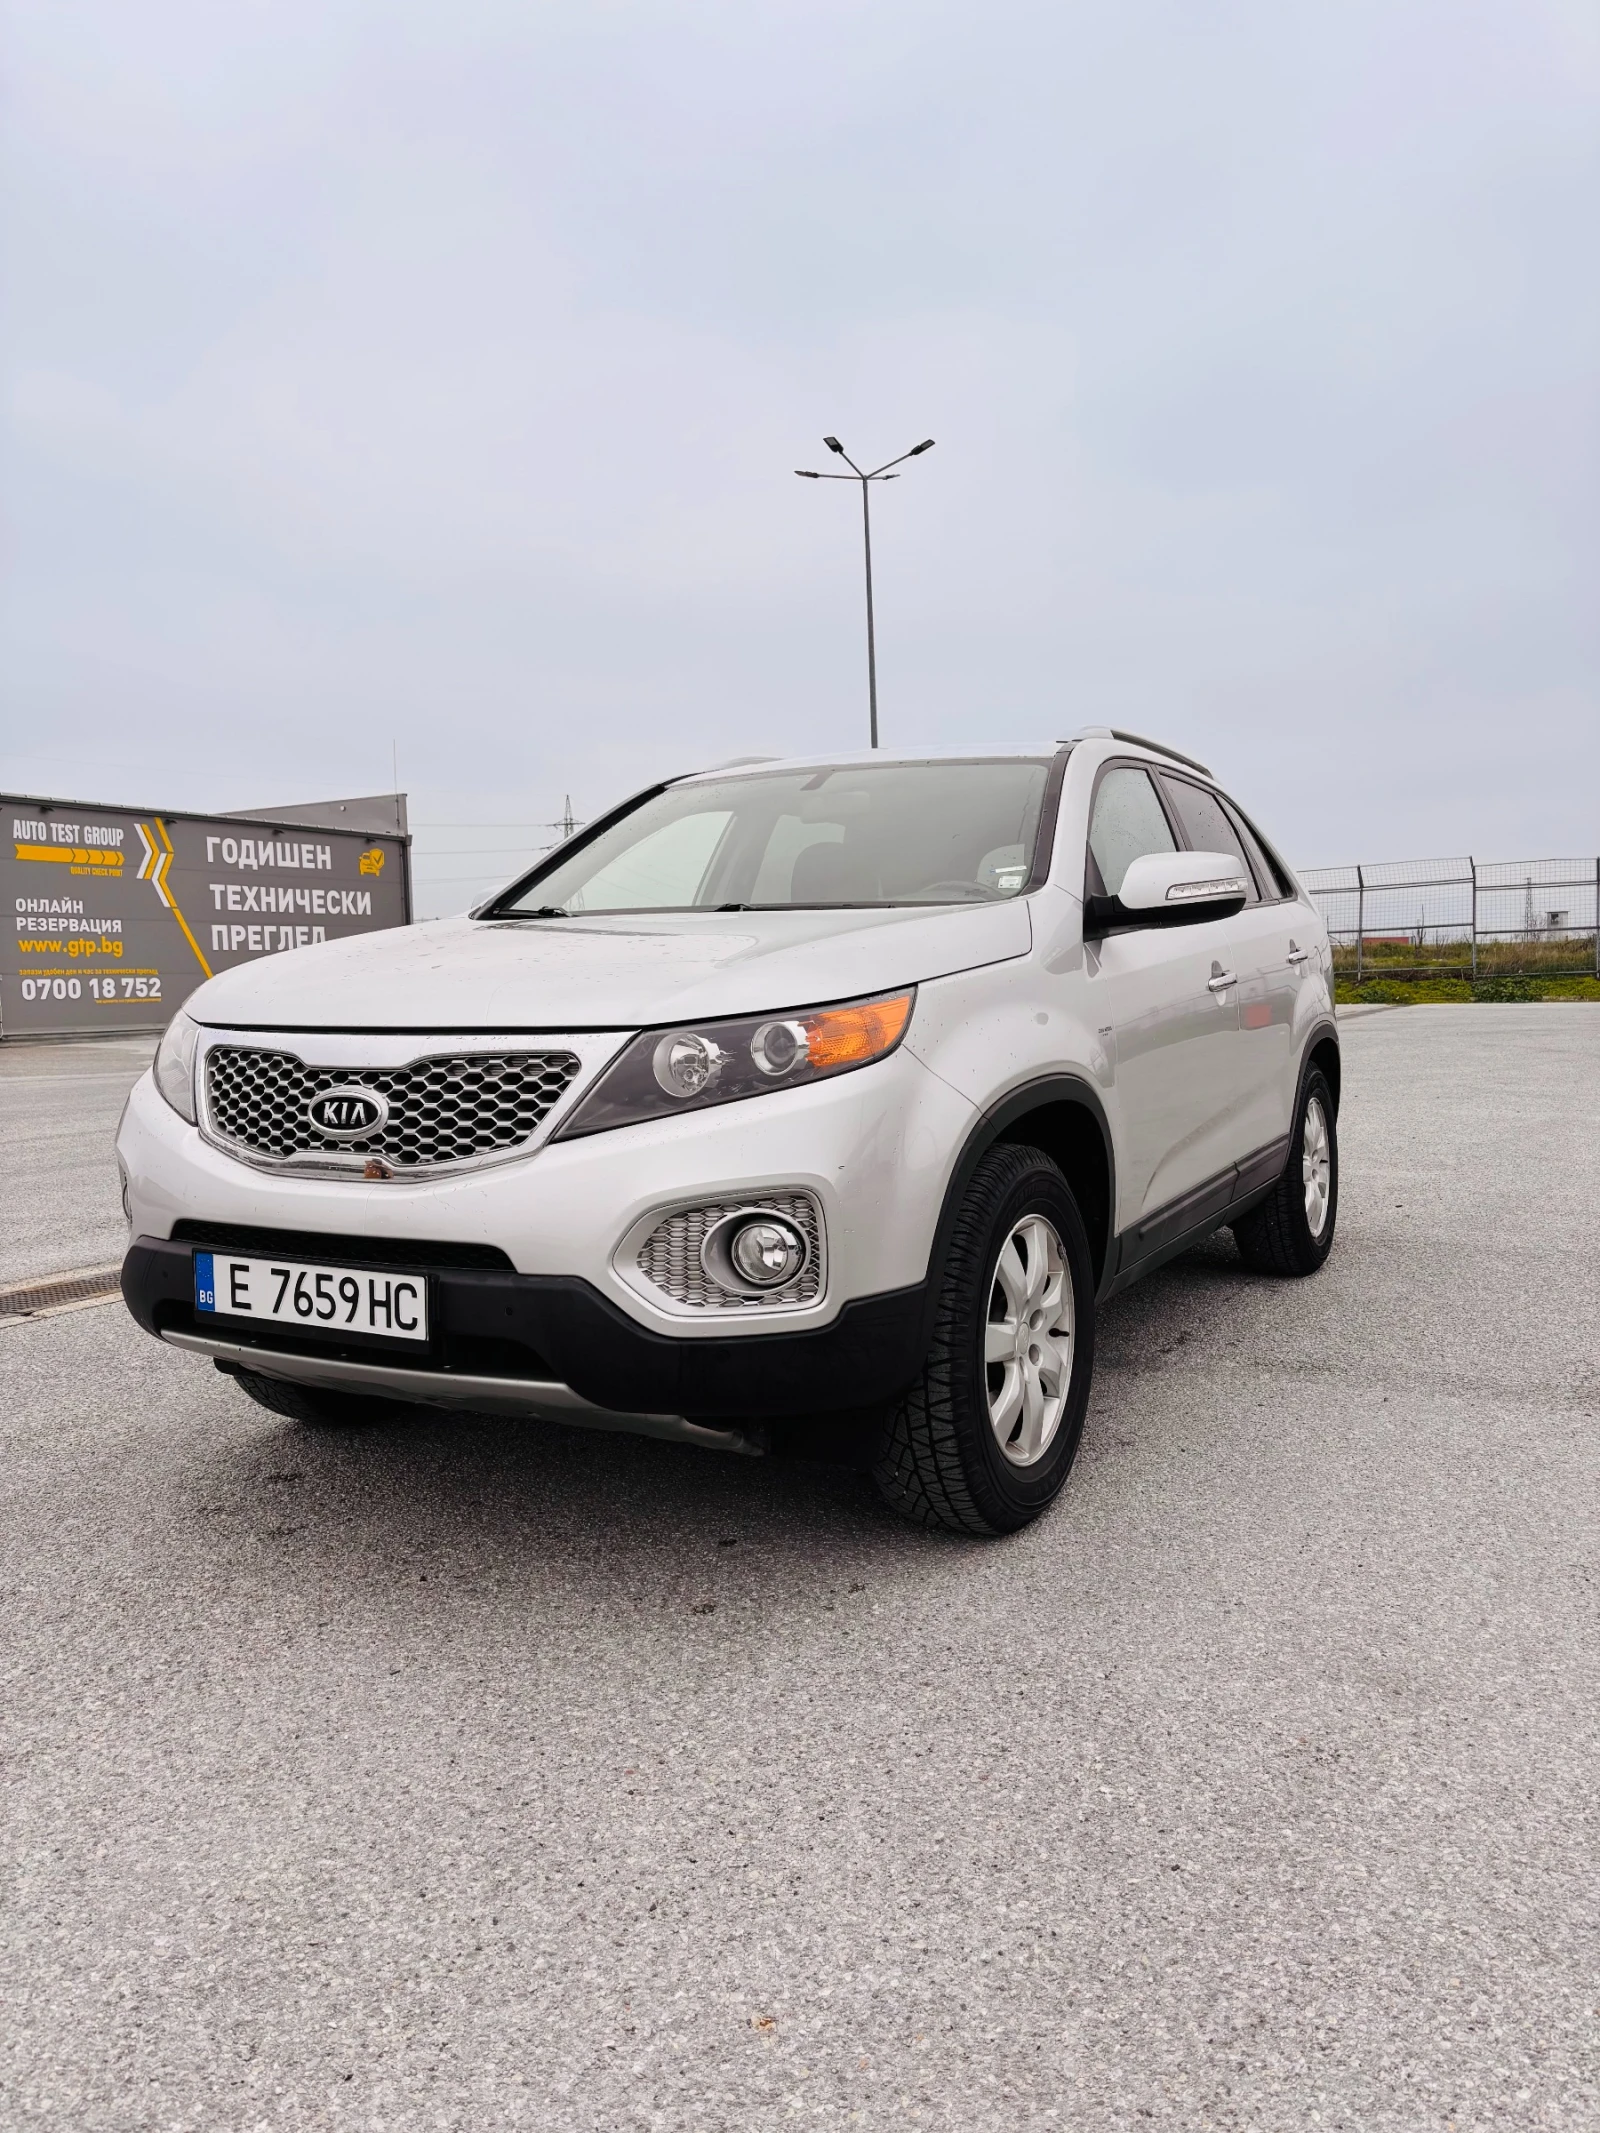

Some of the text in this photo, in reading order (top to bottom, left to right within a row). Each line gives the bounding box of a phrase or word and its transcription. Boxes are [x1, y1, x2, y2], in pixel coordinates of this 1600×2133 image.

[13, 819, 124, 847] AUTO TEST GROUP
[206, 836, 332, 870] ГОДИШЕН
[70, 866, 123, 877] QUALITY CHECK POINT
[15, 896, 84, 914] ОНЛАЙН
[209, 883, 372, 916] ТЕХНИЧЕСКИ
[16, 916, 122, 935] РЕЗЕРВАЦИЯ
[18, 935, 123, 958] www.gtp.bg
[21, 977, 162, 1001] 0700 18 752
[323, 1101, 367, 1125] KIA
[199, 1289, 214, 1304] BG
[230, 1263, 252, 1311] E
